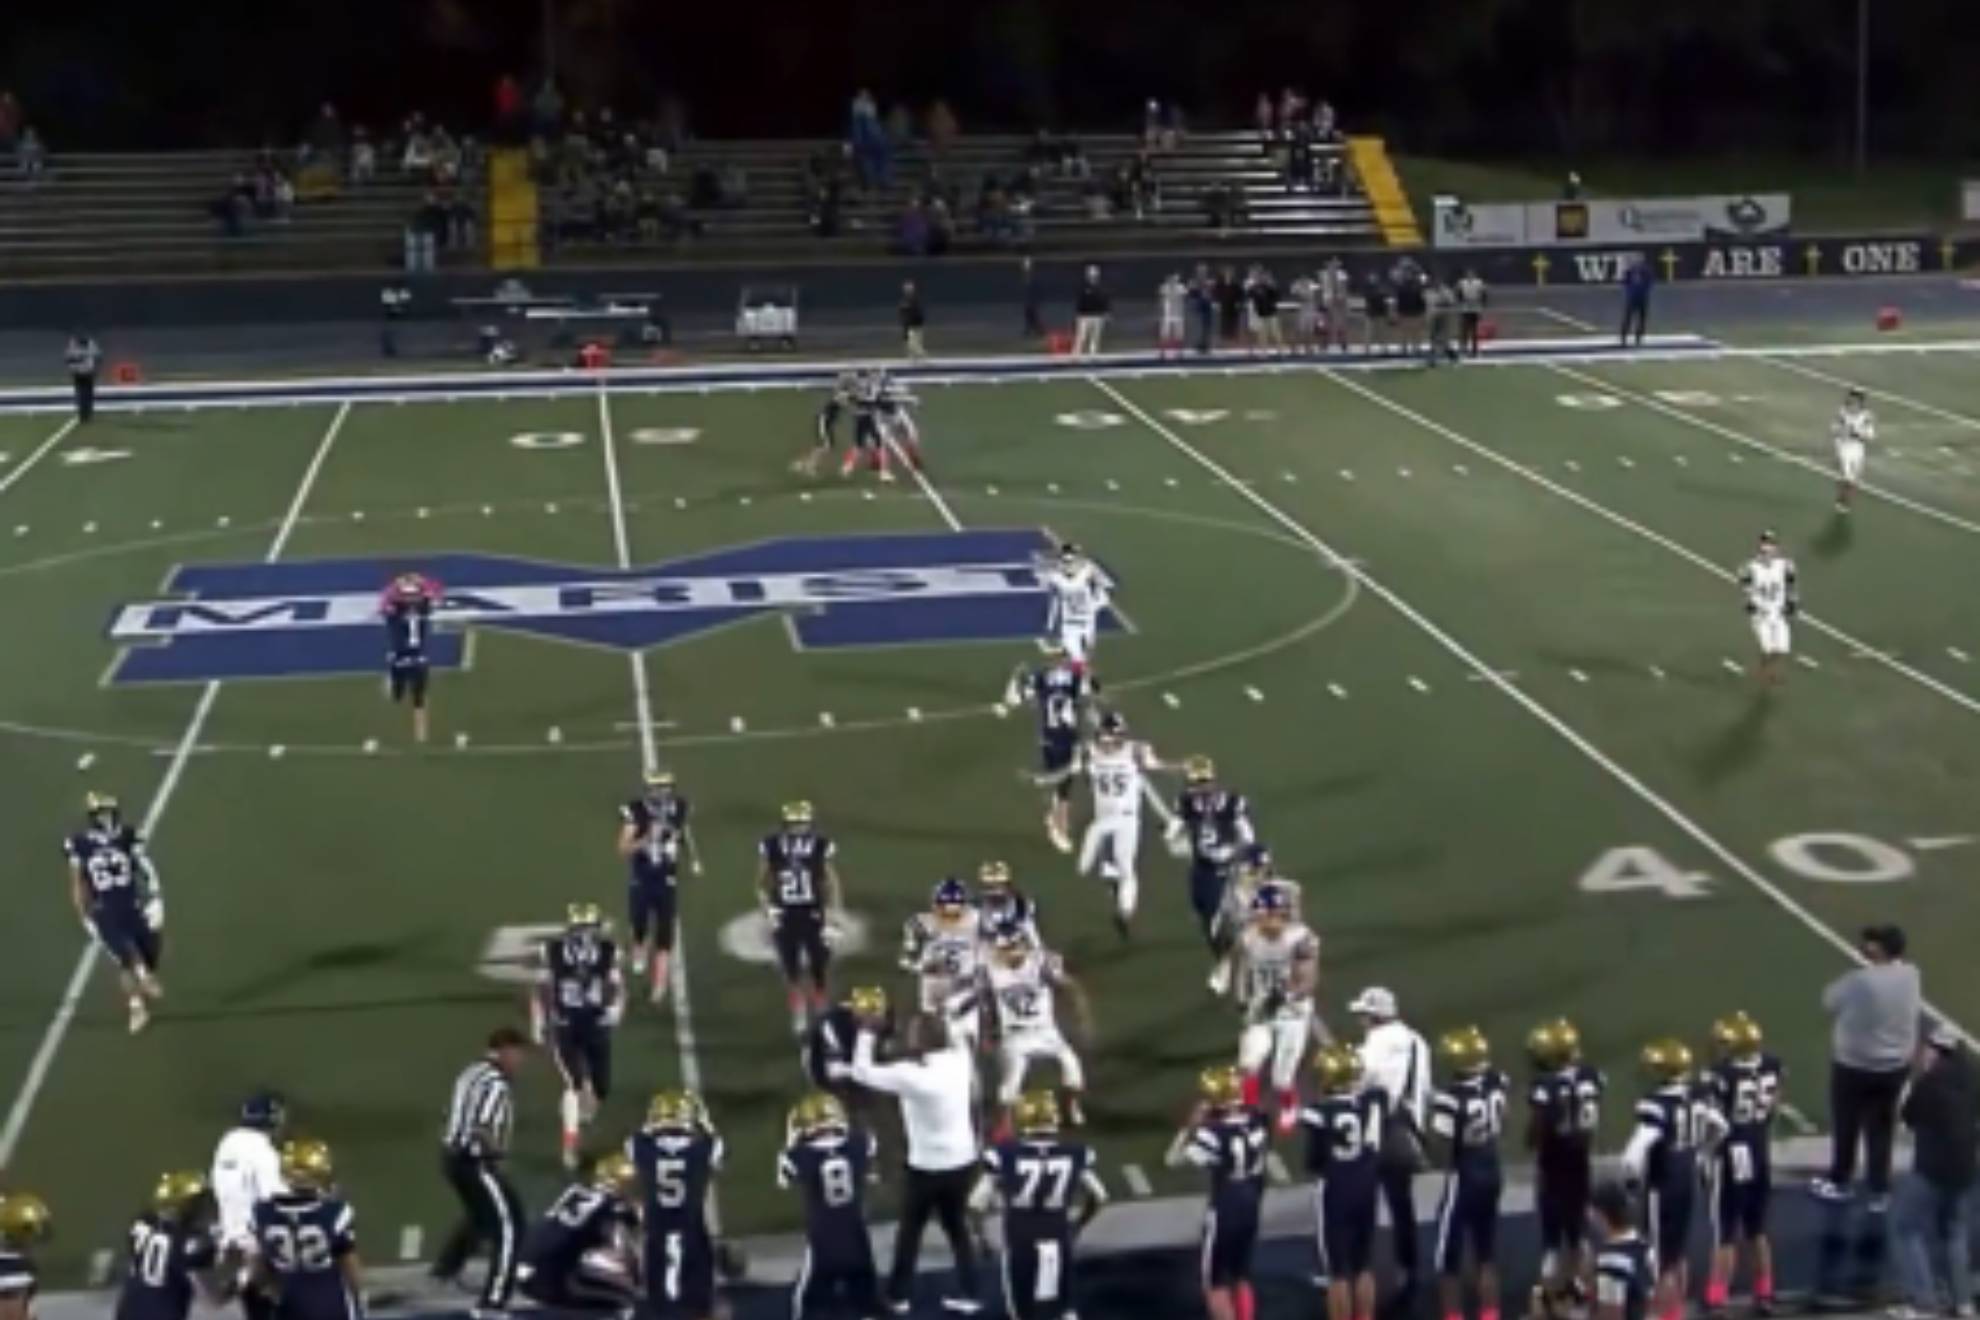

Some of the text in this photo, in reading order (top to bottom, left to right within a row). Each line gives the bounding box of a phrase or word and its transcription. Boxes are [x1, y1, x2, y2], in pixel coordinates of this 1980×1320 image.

[1703, 246, 1783, 276] ARE
[1843, 242, 1919, 272] ONE
[779, 869, 814, 904] 21
[1330, 1102, 1382, 1162] 34
[1463, 1089, 1507, 1146] 20
[655, 1157, 687, 1208] 5
[821, 1157, 853, 1208] 8
[1011, 1157, 1074, 1208] 77
[264, 1223, 333, 1271] 32
